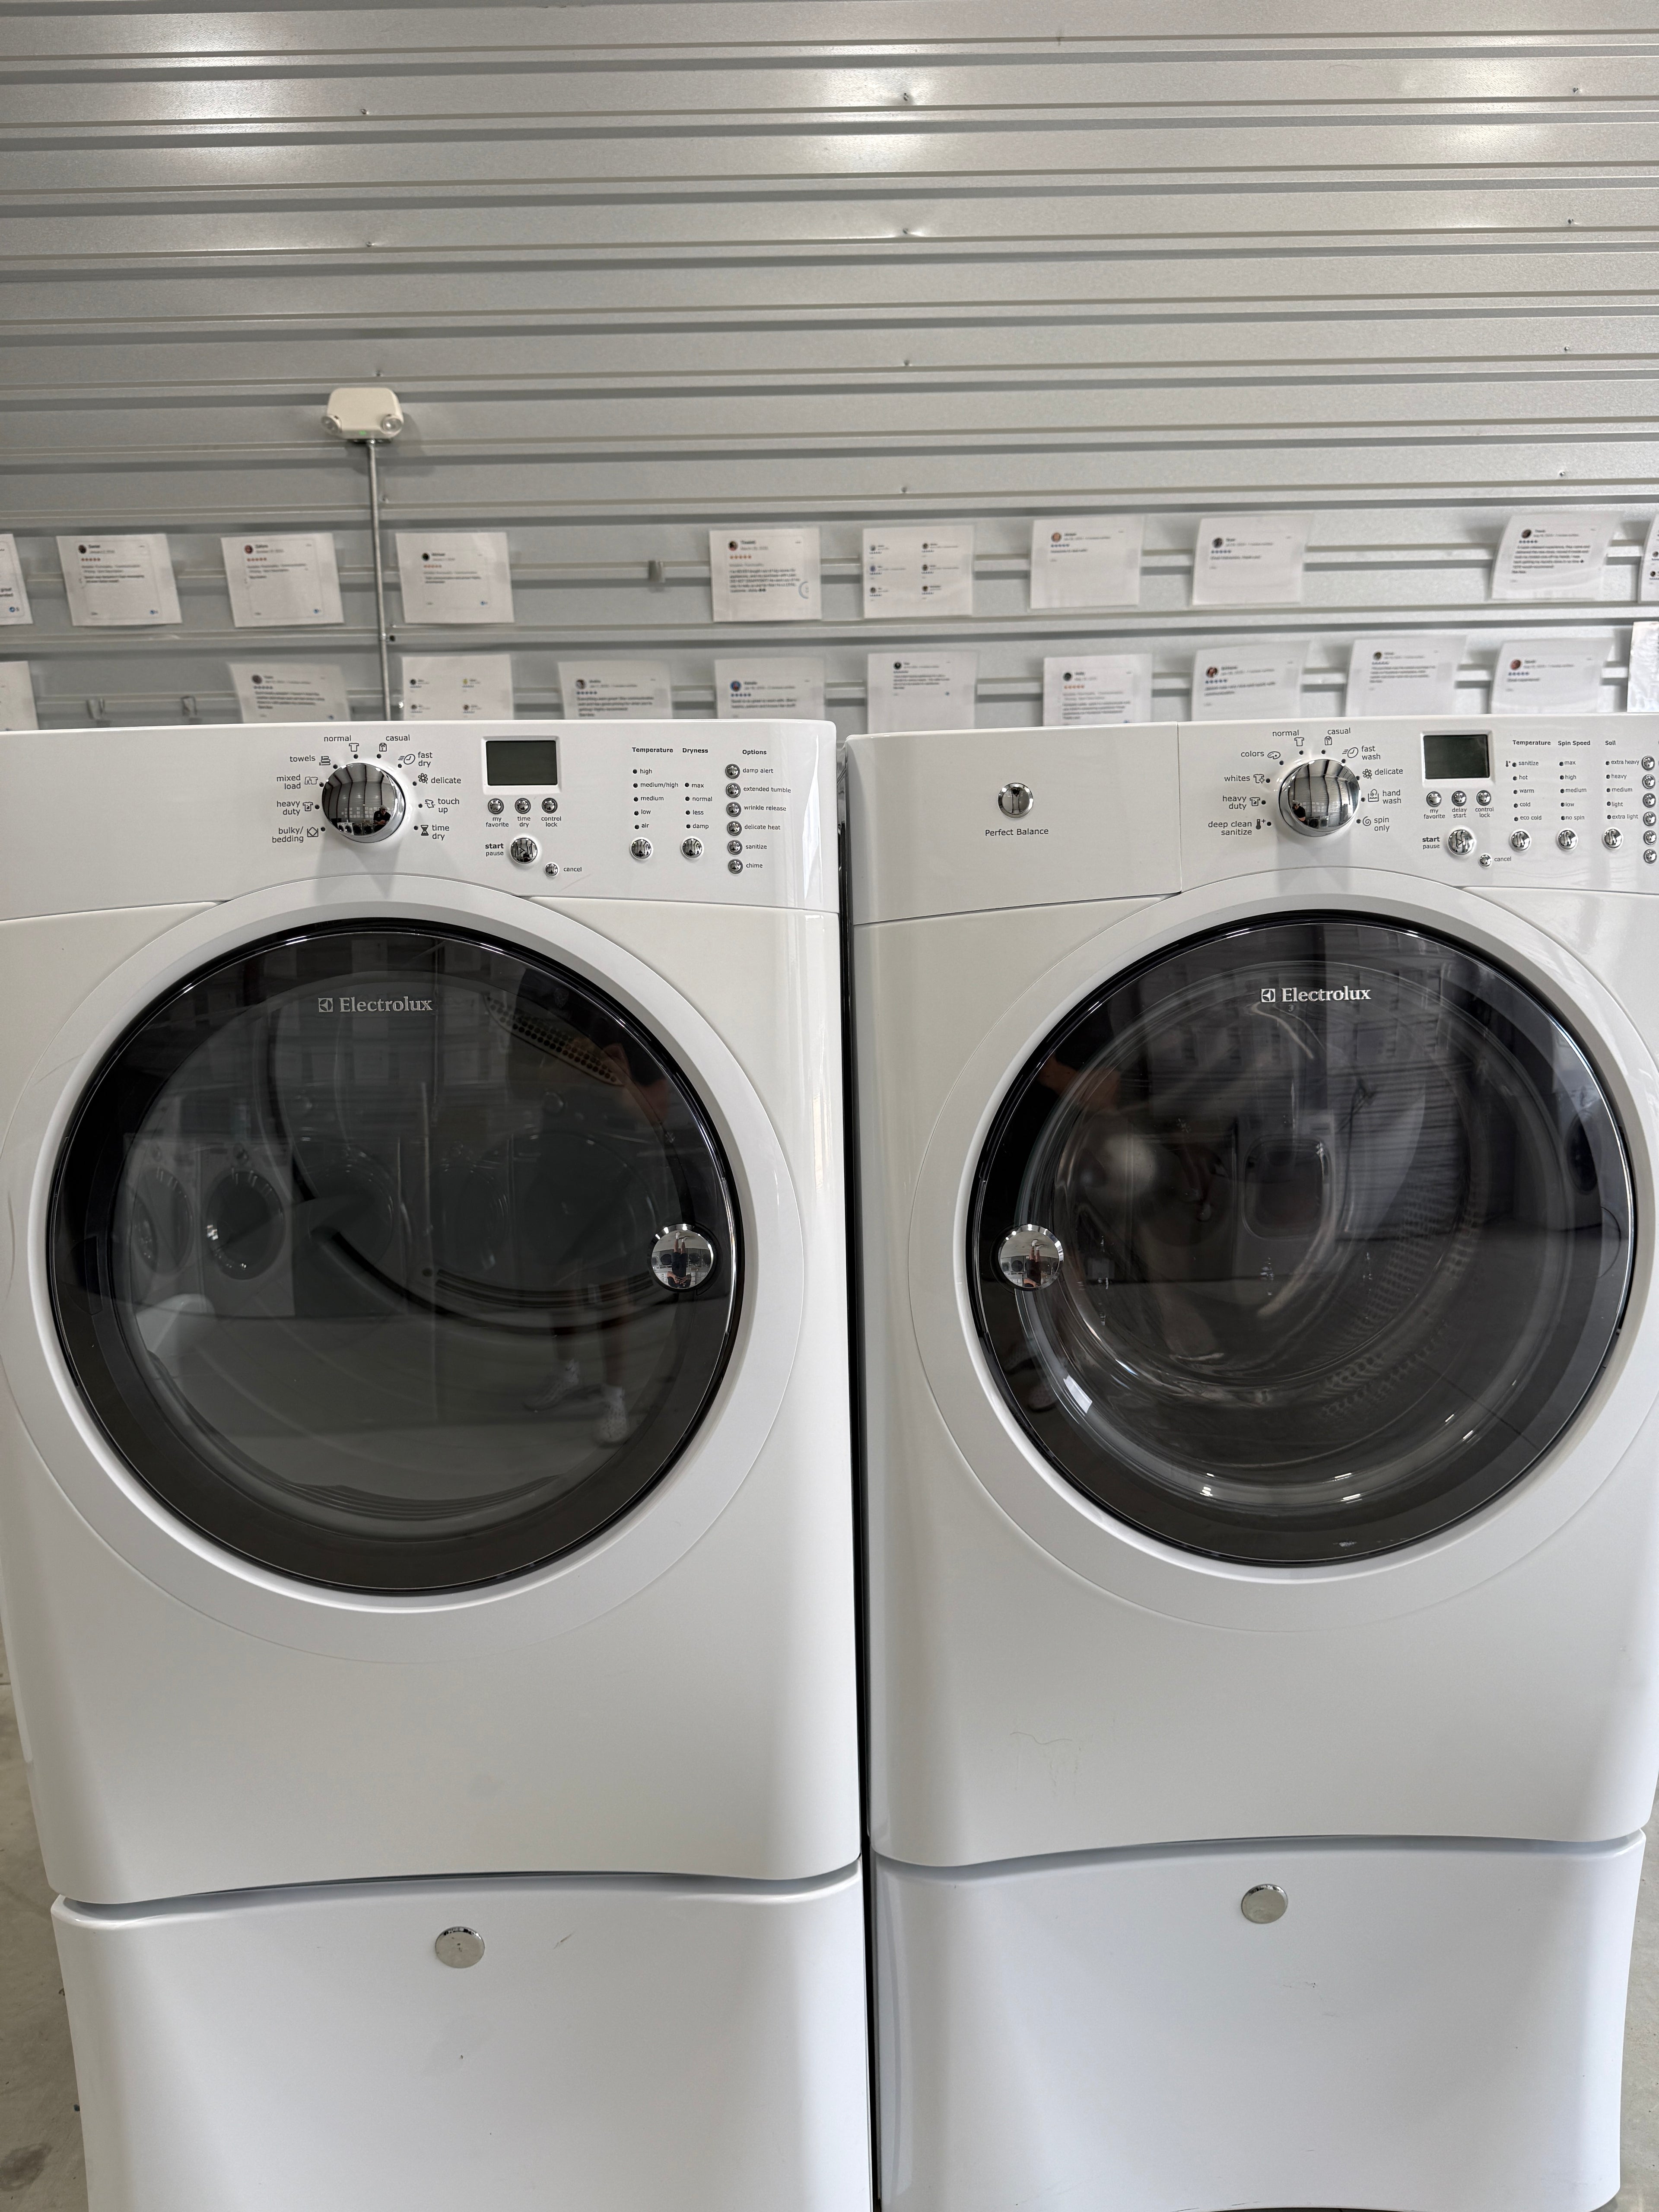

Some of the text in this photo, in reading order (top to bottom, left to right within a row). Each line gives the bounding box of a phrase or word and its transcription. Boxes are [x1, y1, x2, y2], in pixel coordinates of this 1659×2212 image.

[418, 760, 431, 768] dry
[276, 774, 301, 782] mixed
[1223, 795, 1247, 803] heavy
[1229, 802, 1247, 810] duty
[1374, 816, 1389, 824] spin
[1208, 821, 1228, 829] deep
[1374, 824, 1390, 833] only
[278, 826, 304, 835] bulky/
[432, 833, 445, 841] dry
[1281, 985, 1372, 1002] Electrolux
[339, 996, 433, 1012] Electrolux
